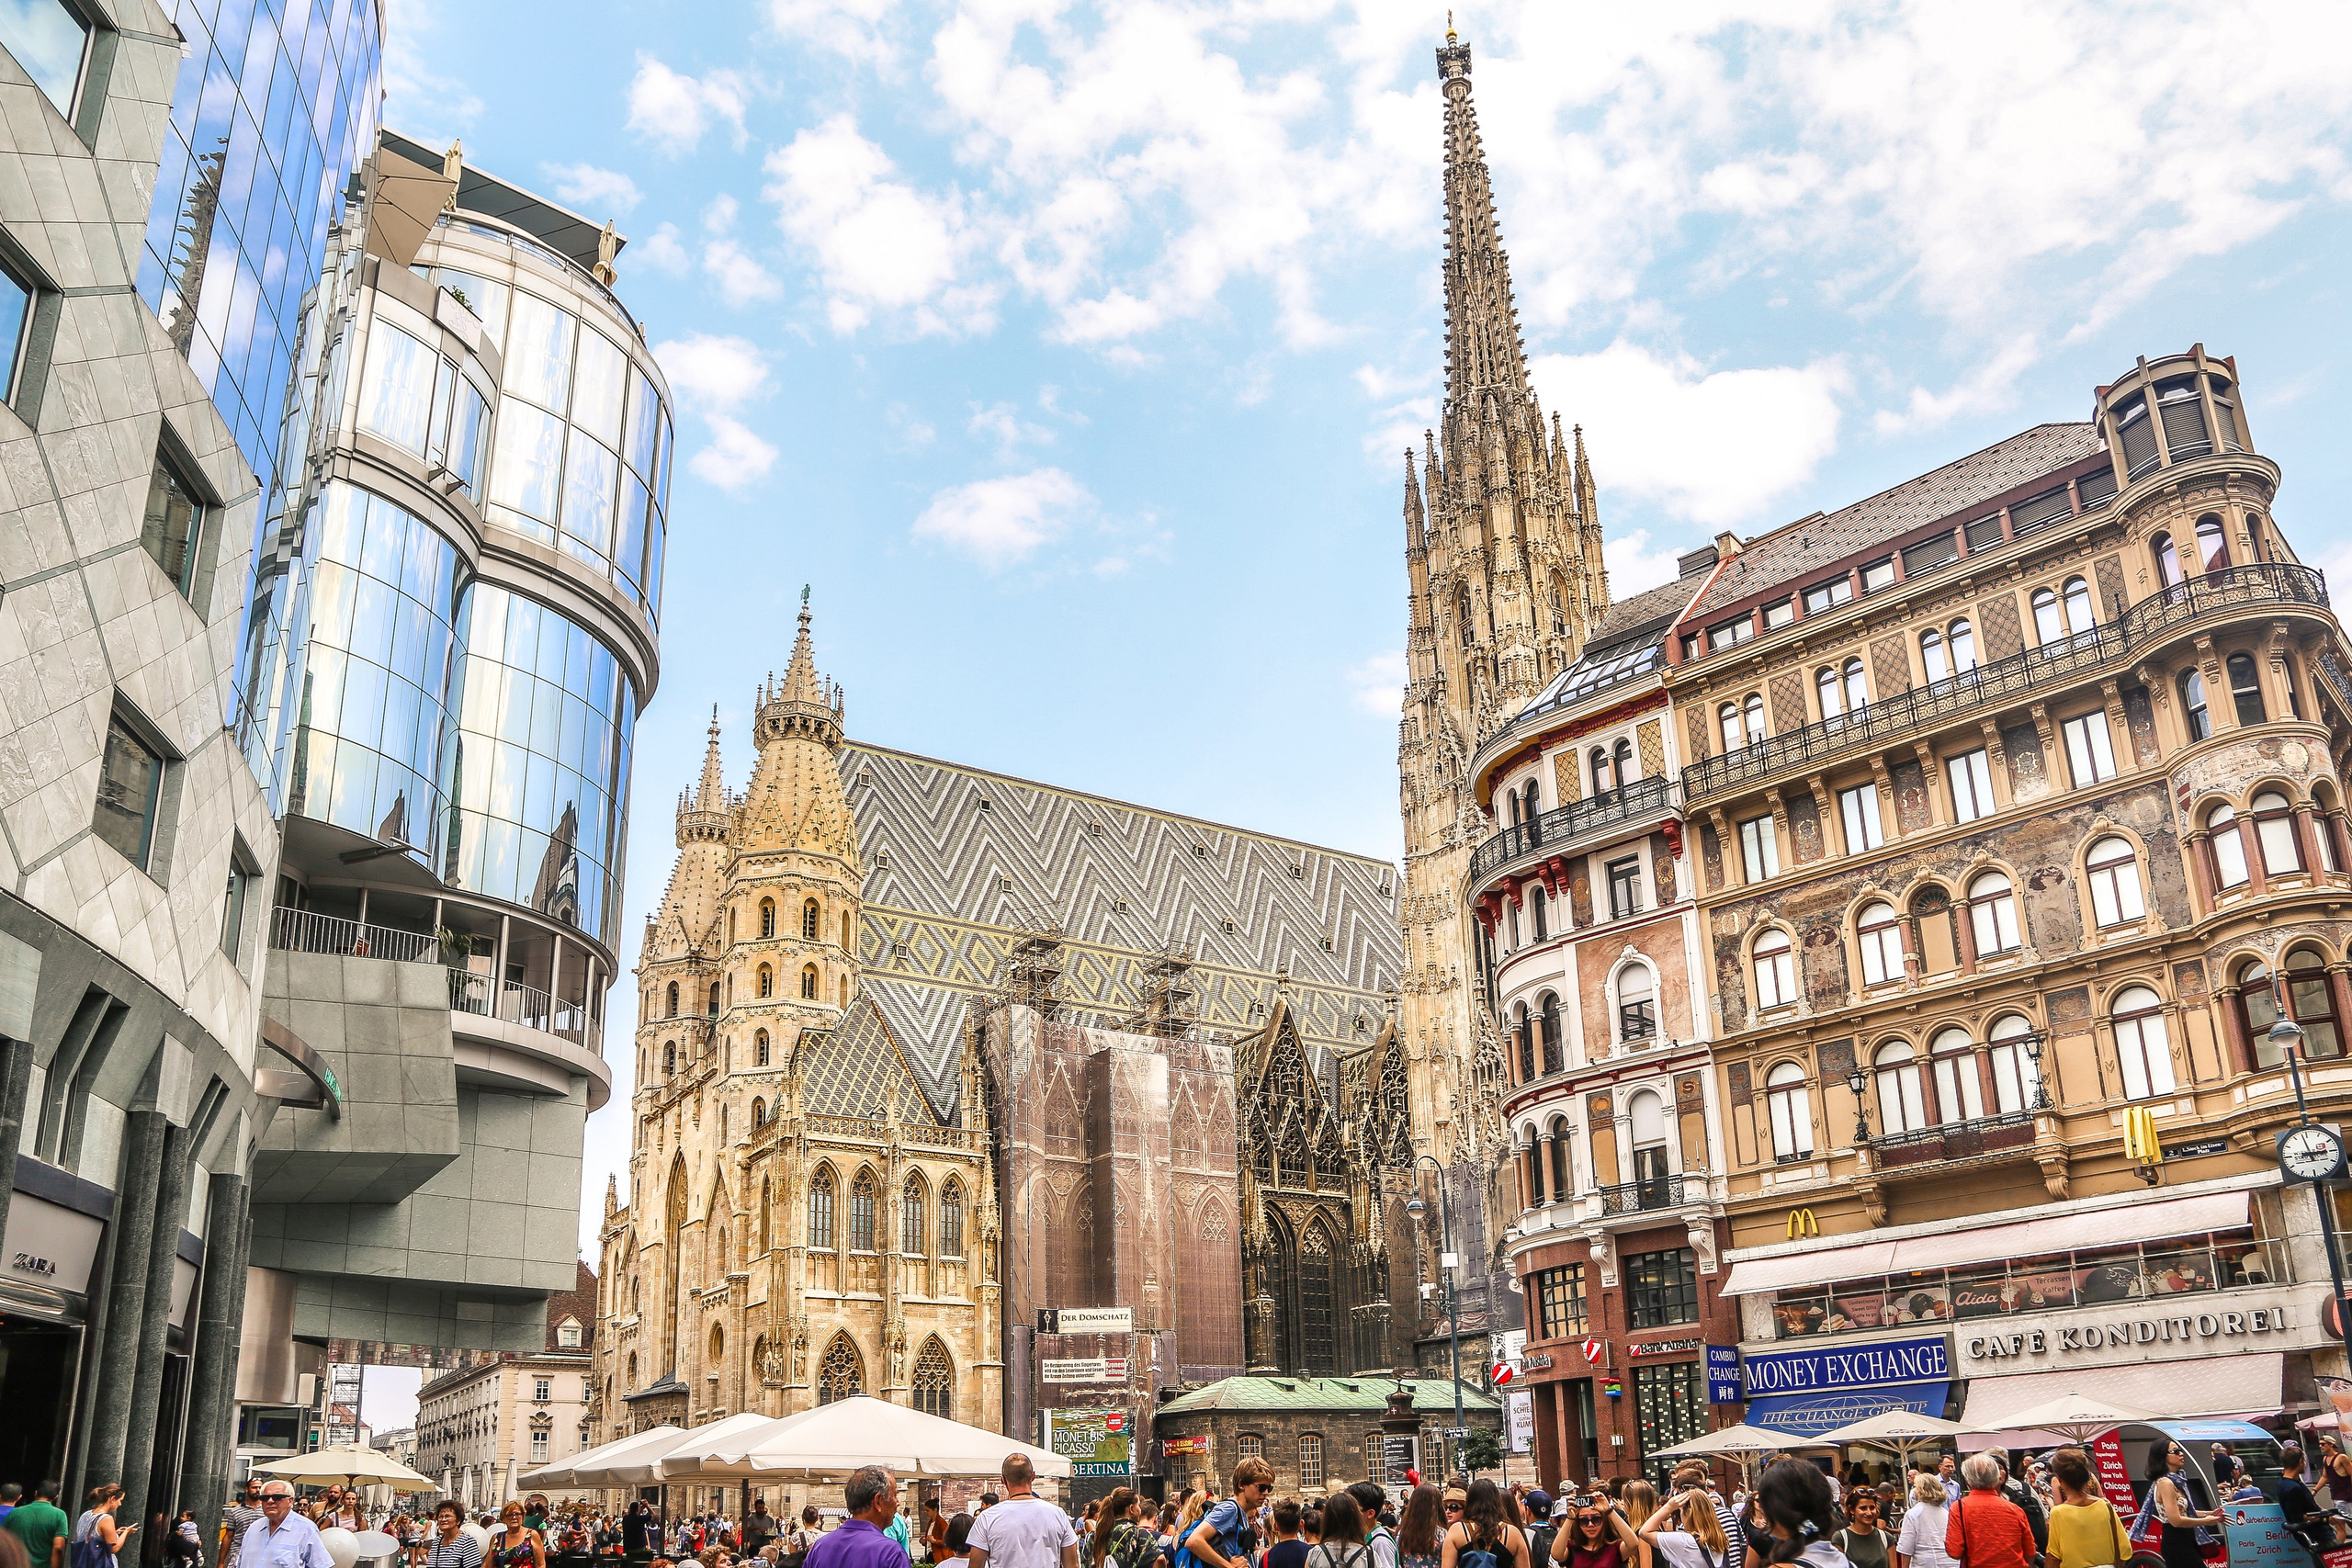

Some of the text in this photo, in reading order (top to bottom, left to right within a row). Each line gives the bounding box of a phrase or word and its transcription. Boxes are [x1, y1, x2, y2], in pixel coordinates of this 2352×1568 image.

[12, 1252, 56, 1275] ZARA
[2035, 1276, 2071, 1285] Terrassen
[2042, 1285, 2066, 1294] Kaffee
[1965, 1306, 2287, 1359] CAFÉ KONDITOREI
[1640, 1339, 1698, 1354] Bank Austria
[1710, 1350, 1736, 1362] CAMBIO
[1744, 1344, 1948, 1391] MONEY EXCHANGE
[1708, 1367, 1741, 1381] CHANGE
[1761, 1411, 1793, 1423] THE
[1794, 1407, 1866, 1422] CHANGE
[1054, 1432, 1088, 1443] MONET
[1054, 1443, 1096, 1453] PICASSO
[2101, 1442, 2118, 1450] Paris
[1074, 1463, 1125, 1475] BERTINA
[2103, 1461, 2123, 1470] Zürich
[2103, 1481, 2130, 1492] Chicago
[2113, 1504, 2134, 1513] Berlin
[2265, 1530, 2292, 1540] Berlin
[2256, 1545, 2282, 1555] Zürich
